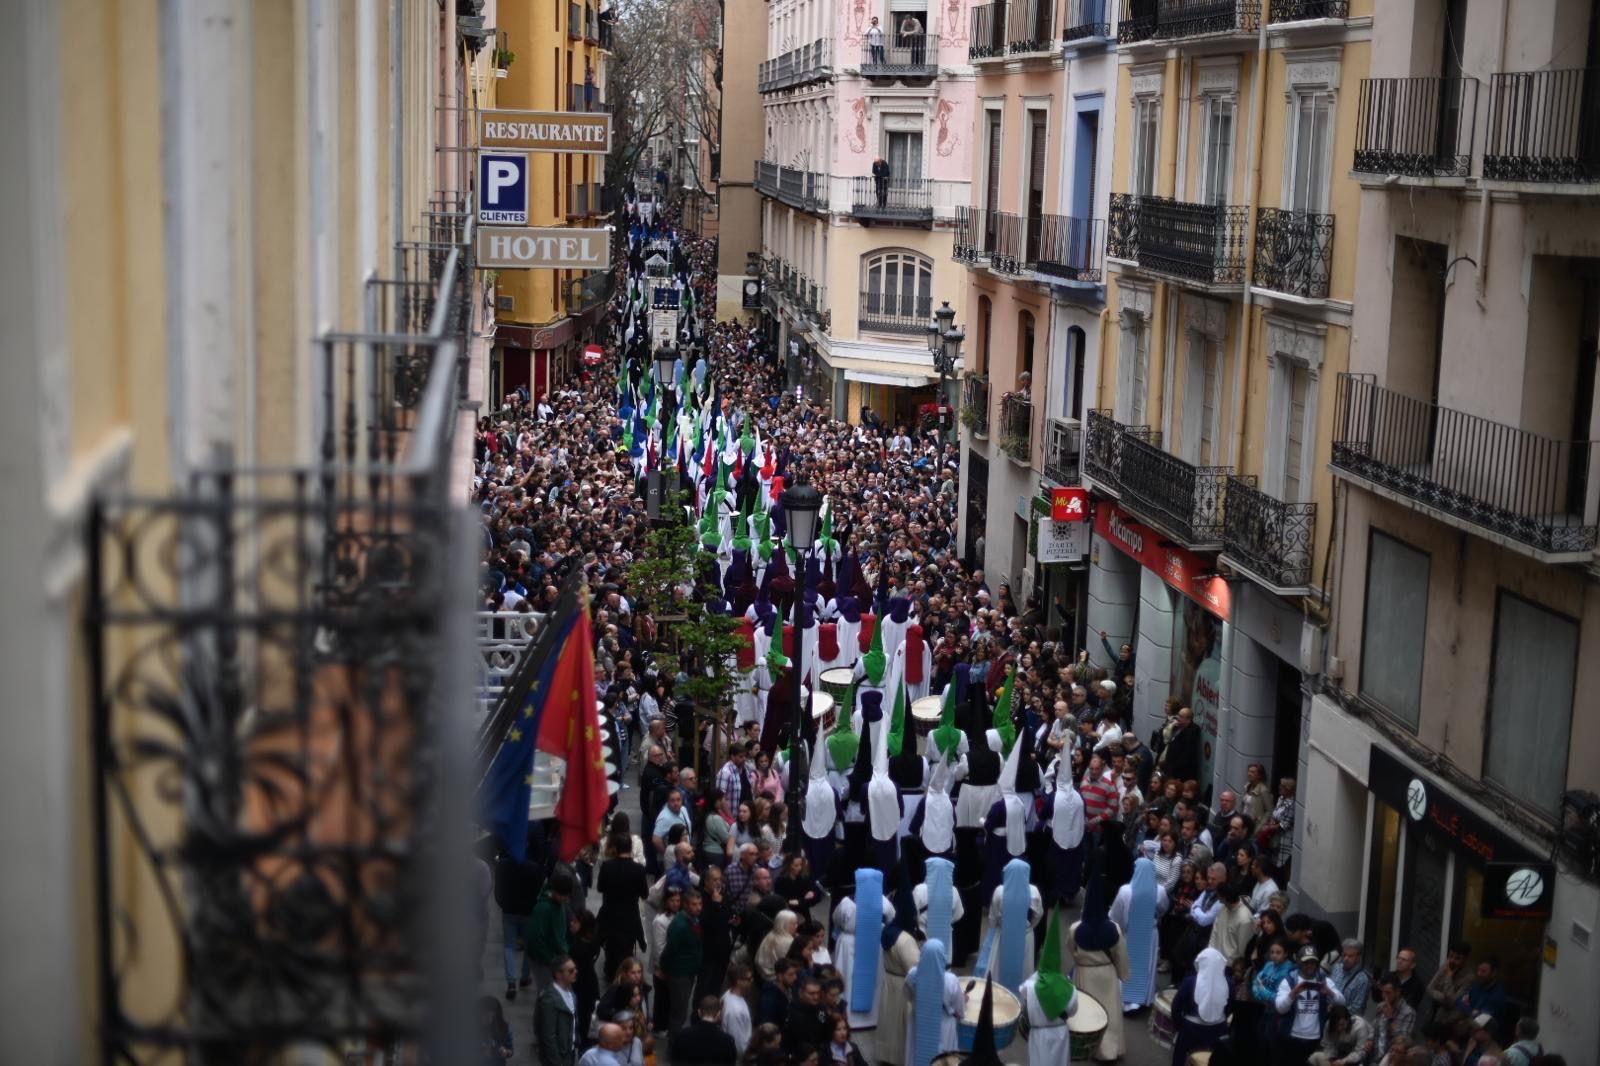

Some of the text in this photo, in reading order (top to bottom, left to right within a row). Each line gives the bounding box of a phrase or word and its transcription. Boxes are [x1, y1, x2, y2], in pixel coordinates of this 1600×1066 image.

[485, 121, 604, 142] RESTAURANTE
[488, 161, 520, 204] P
[480, 211, 525, 222] CLIENTES
[490, 235, 599, 262] HOTEL
[1108, 509, 1143, 553] Alcampo
